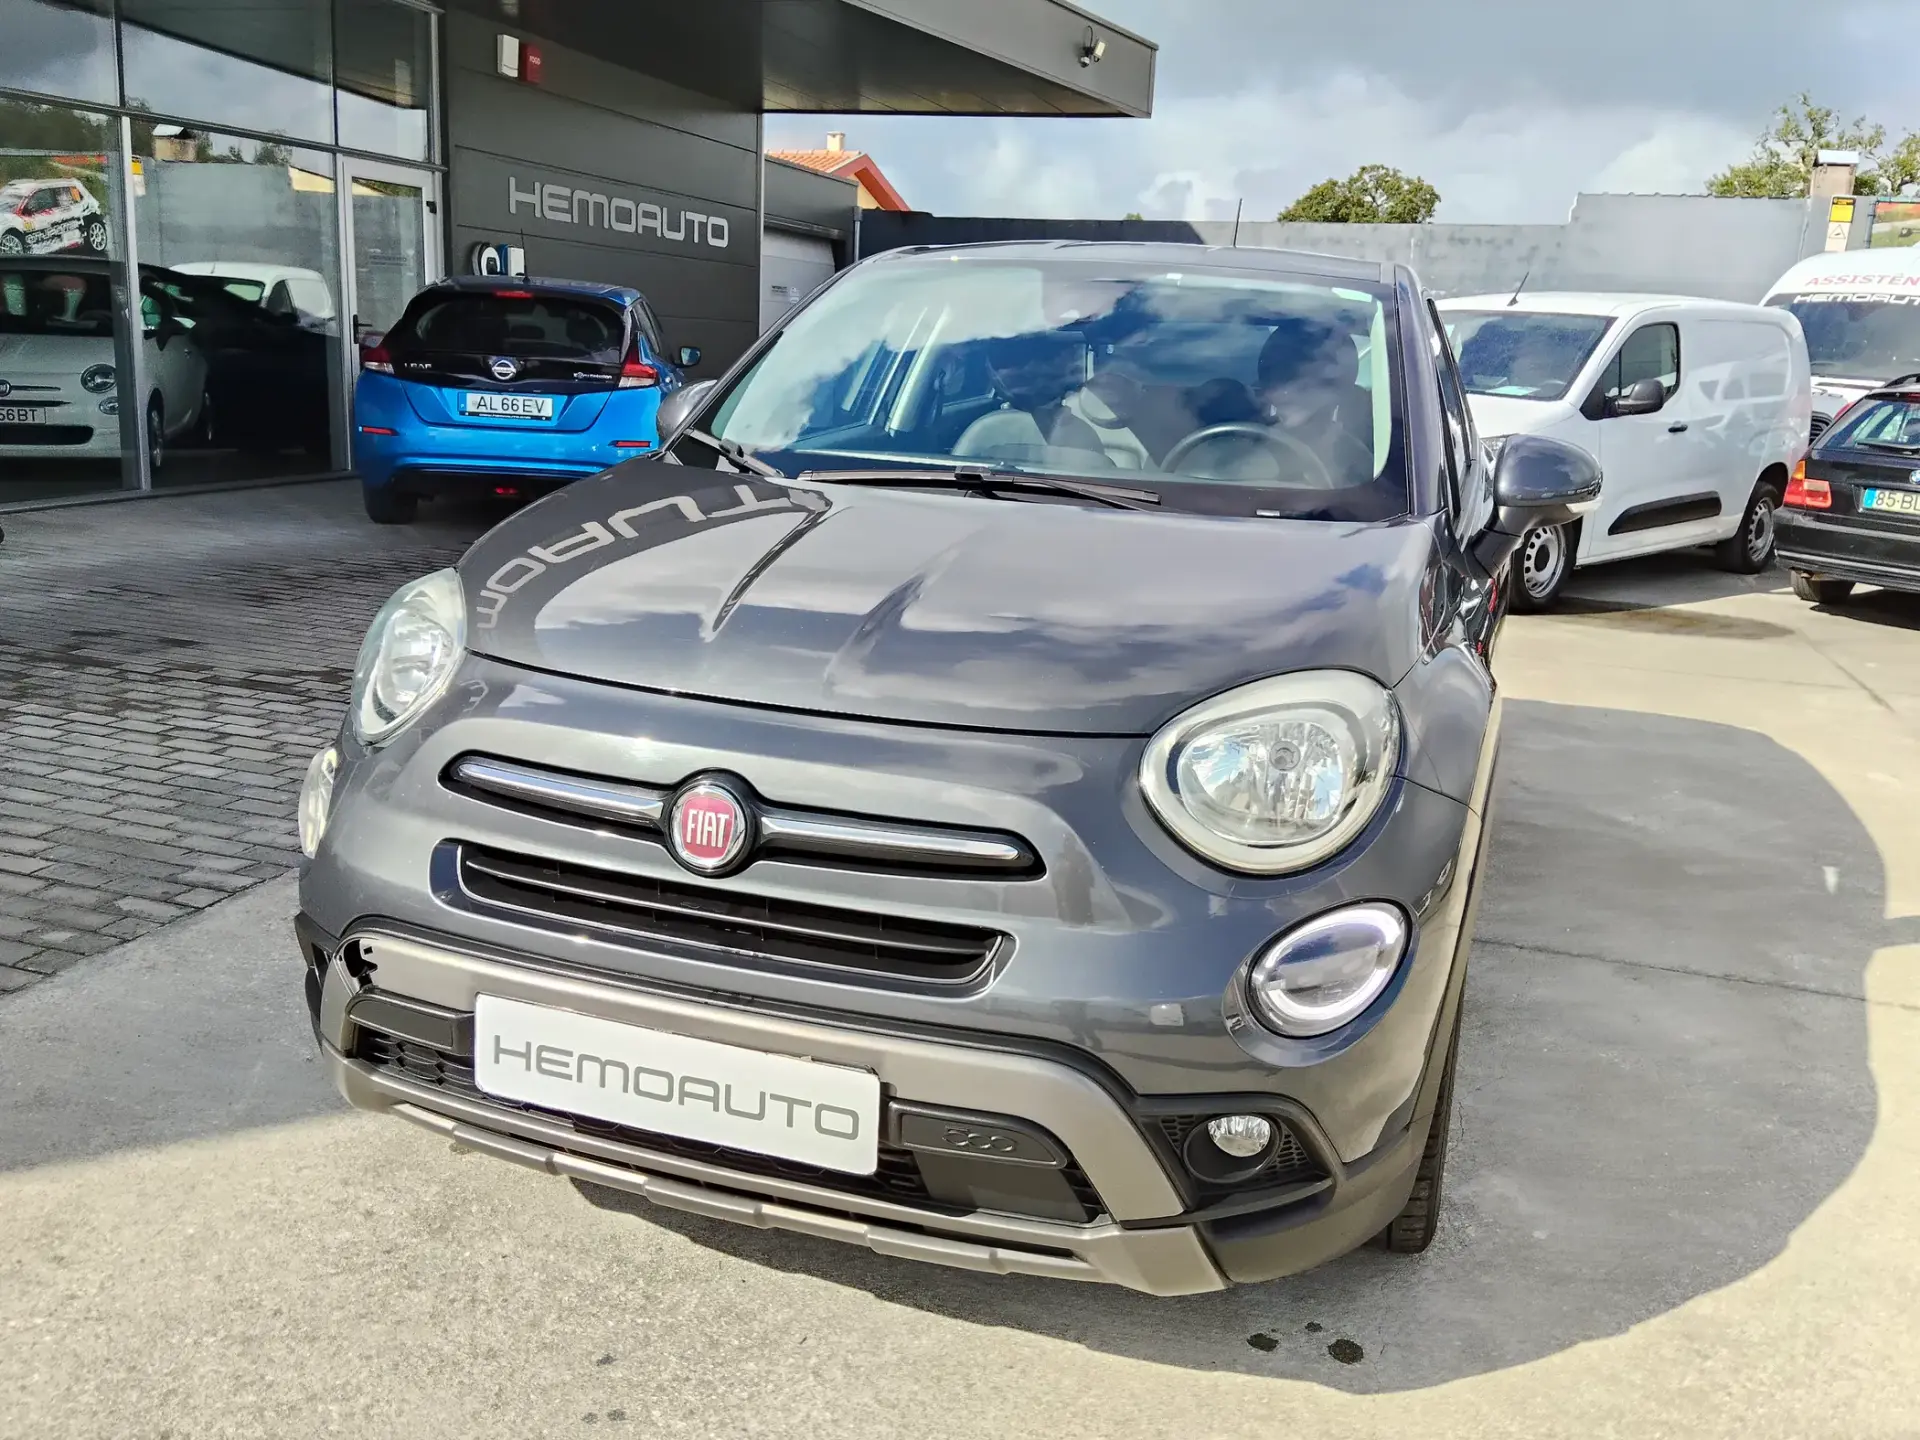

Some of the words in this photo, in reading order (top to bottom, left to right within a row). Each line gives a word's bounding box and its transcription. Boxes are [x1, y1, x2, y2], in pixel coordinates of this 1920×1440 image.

[508, 177, 729, 248] HEMOAUTO
[476, 396, 498, 411] AL
[501, 397, 520, 412] 66
[522, 398, 545, 413] EV
[686, 808, 730, 848] FIAT
[493, 1034, 860, 1141] HEMOAUTO
